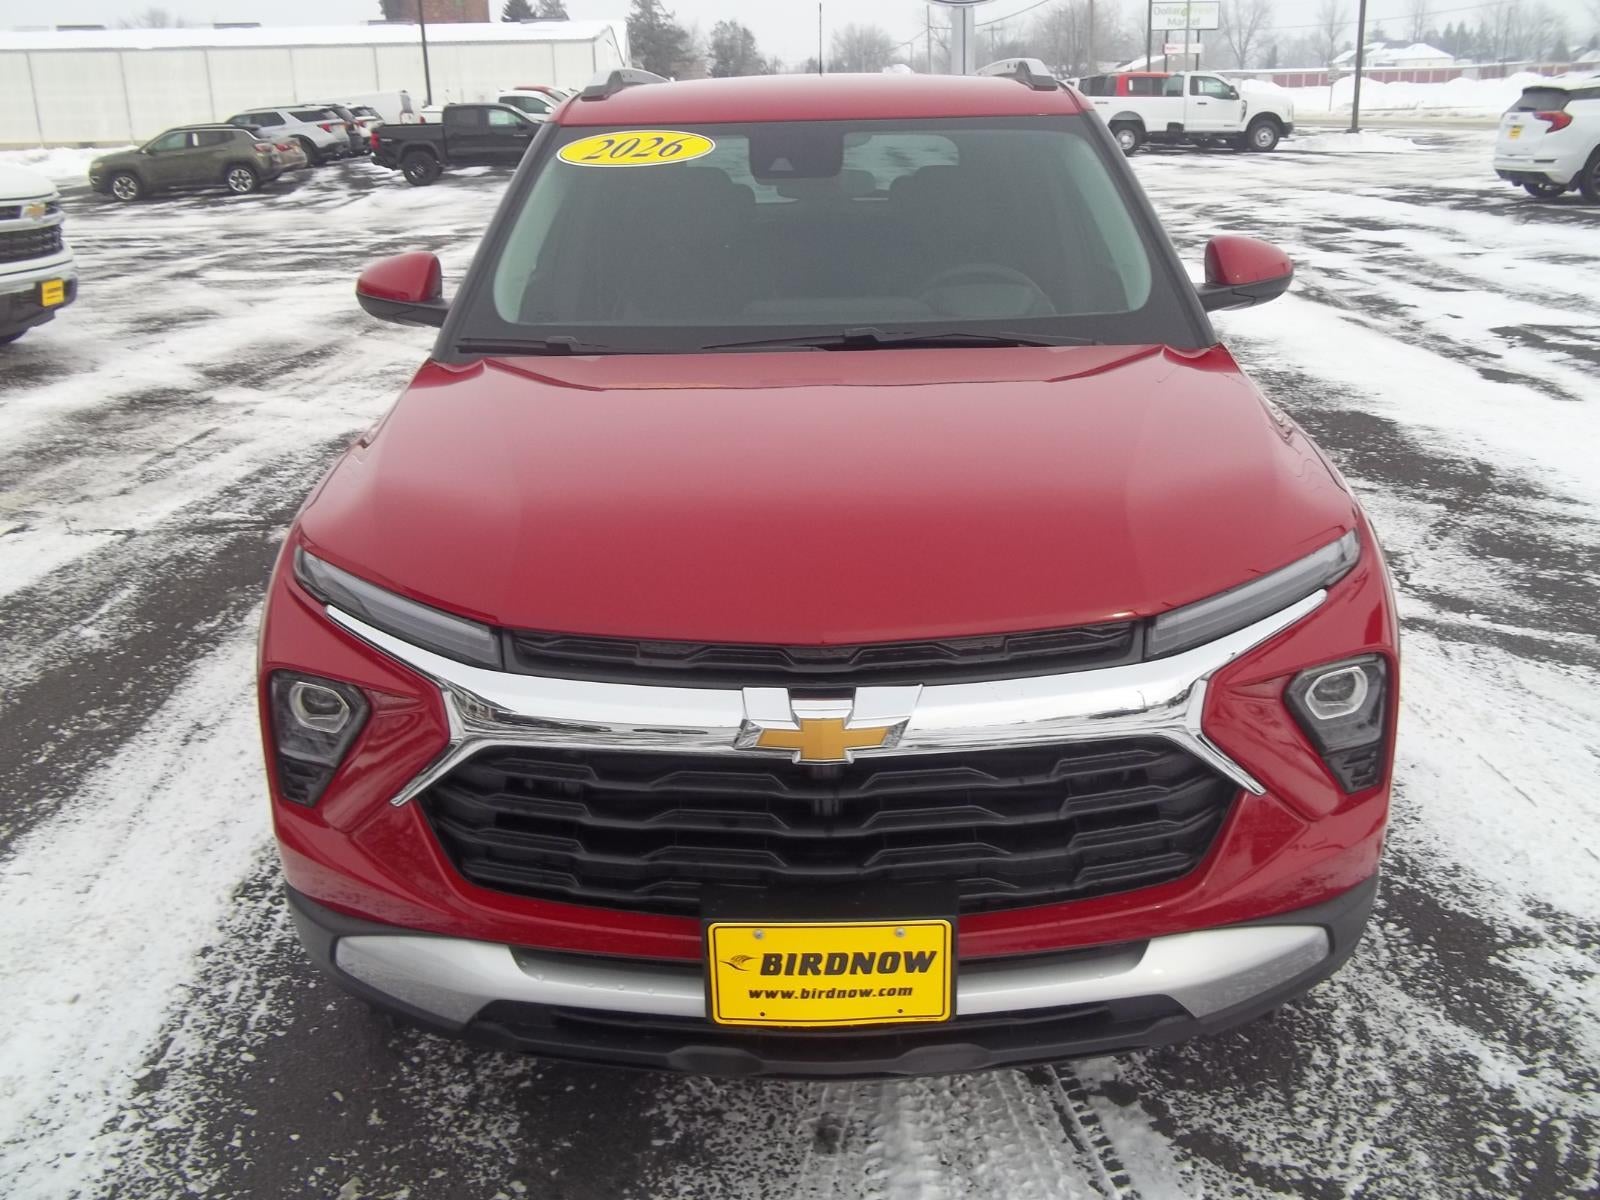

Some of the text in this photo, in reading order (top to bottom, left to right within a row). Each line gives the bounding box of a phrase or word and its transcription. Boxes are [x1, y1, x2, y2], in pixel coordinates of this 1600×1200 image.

[1167, 17, 1200, 26] Maret
[581, 137, 693, 161] 2026
[760, 951, 937, 976] BIRDNOW
[748, 986, 913, 1000] www.birdnow.com
